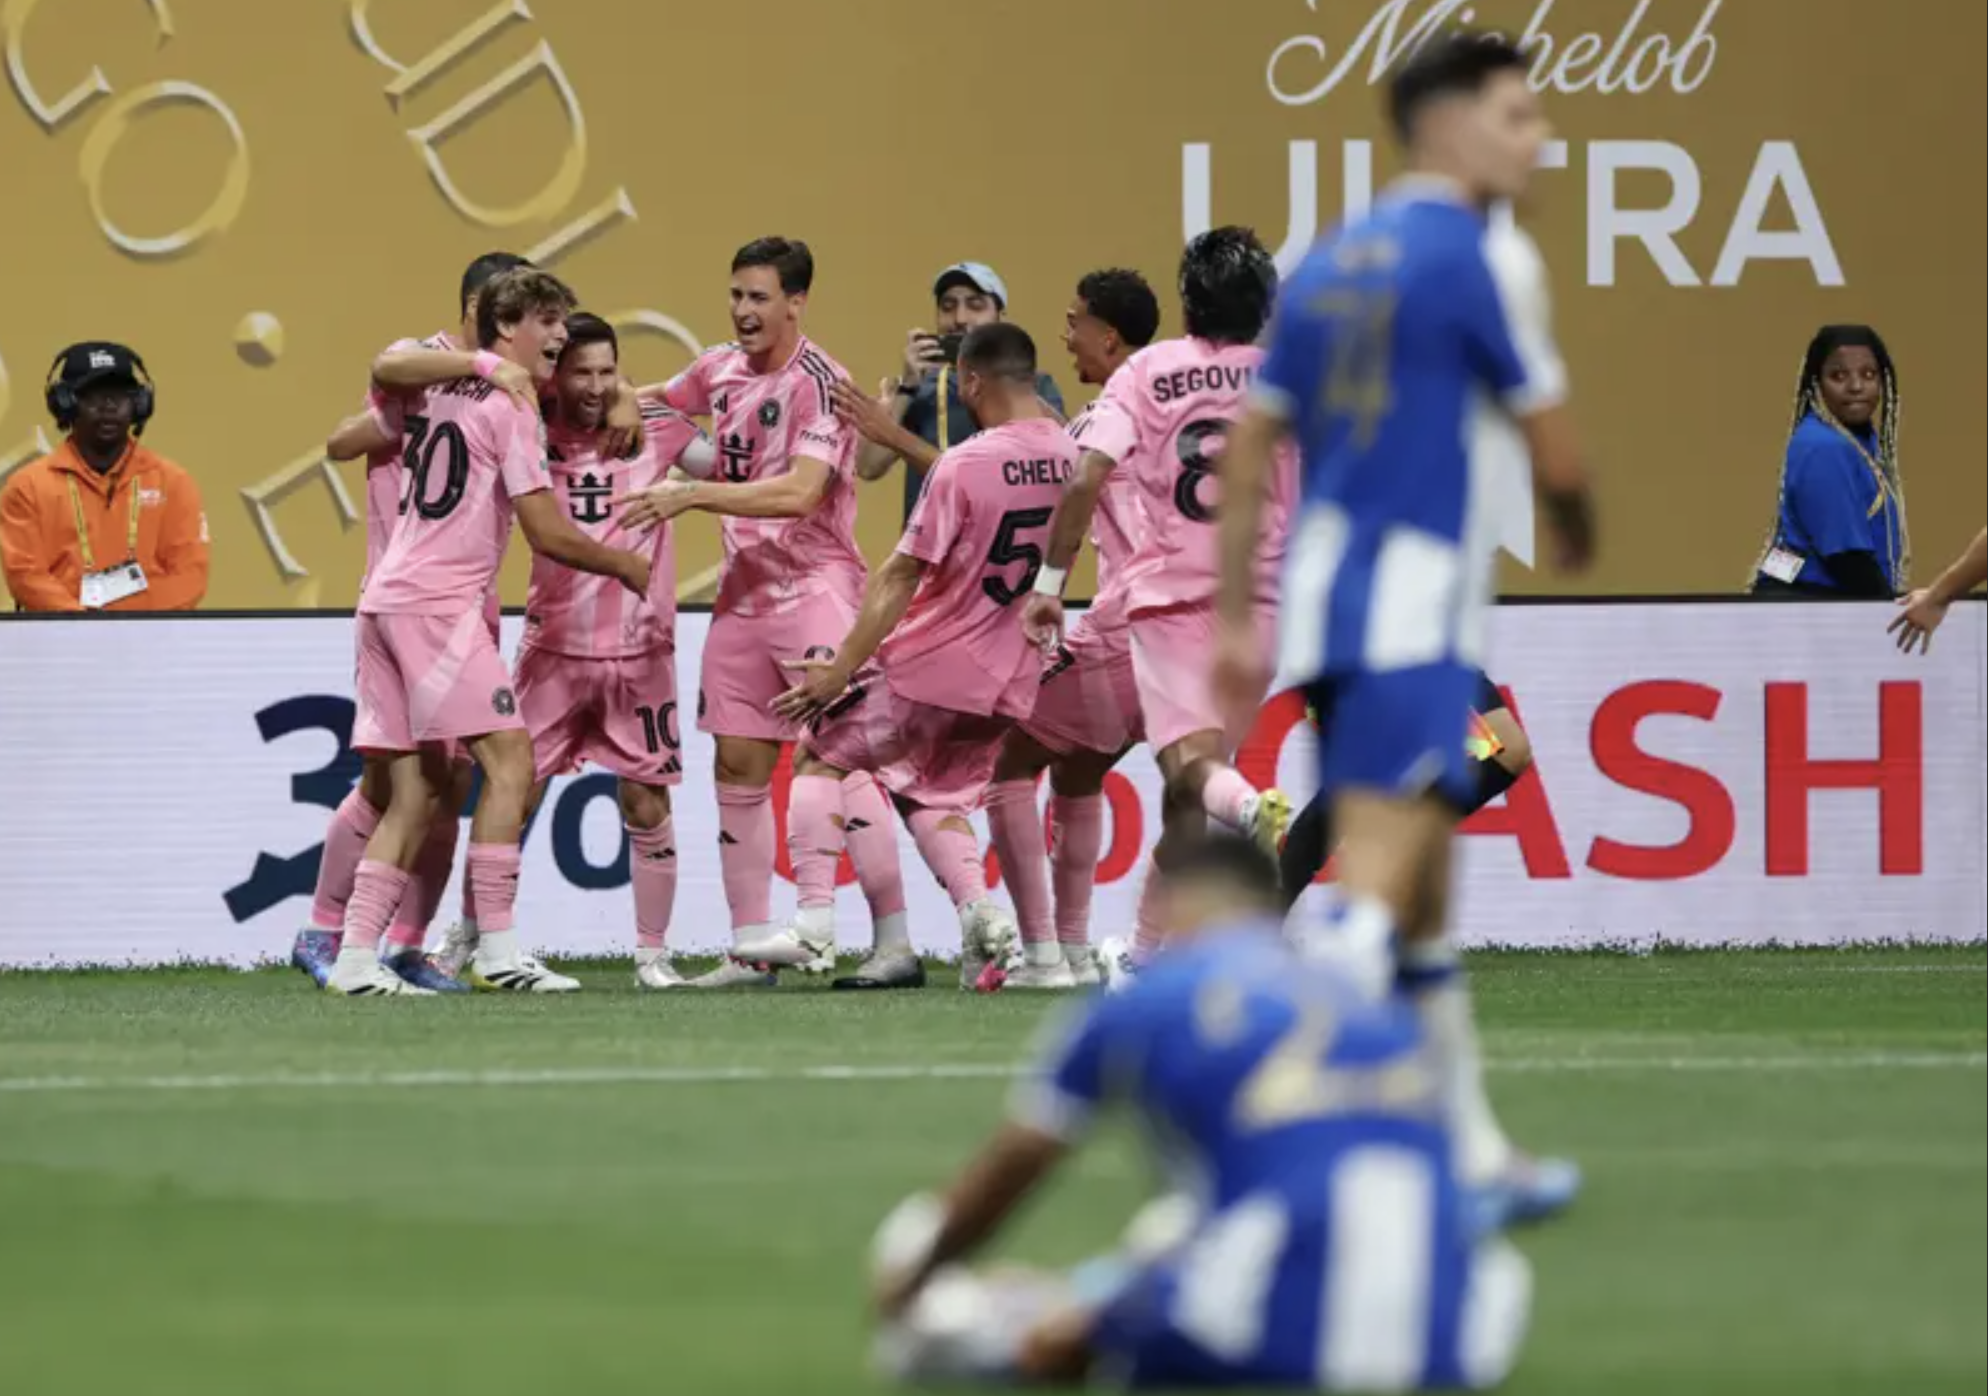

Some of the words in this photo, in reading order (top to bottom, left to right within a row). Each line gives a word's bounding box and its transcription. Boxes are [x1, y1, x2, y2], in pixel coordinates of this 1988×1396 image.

[1266, 0, 1719, 105] Mhelob
[1182, 139, 1847, 287] URA
[398, 413, 471, 522] 30
[1173, 418, 1234, 523] 8
[982, 506, 1053, 607] 5
[634, 702, 680, 754] 10
